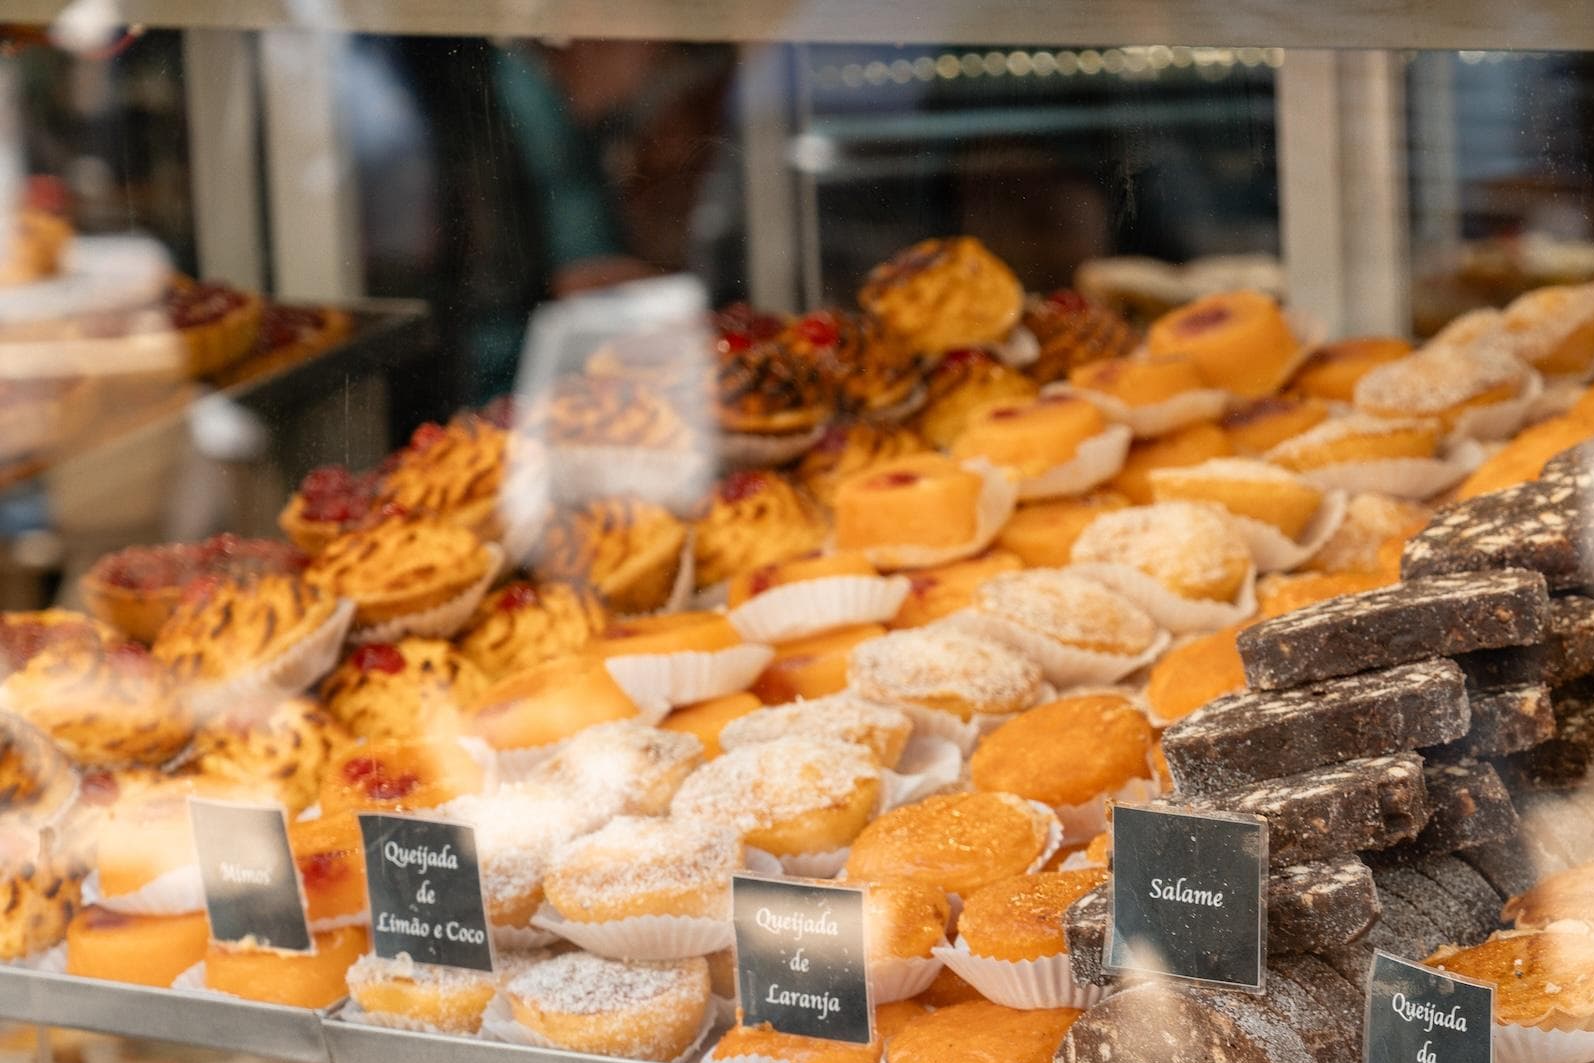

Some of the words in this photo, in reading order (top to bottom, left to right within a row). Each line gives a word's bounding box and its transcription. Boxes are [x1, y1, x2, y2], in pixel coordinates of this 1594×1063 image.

[384, 841, 459, 875] Queijada
[416, 880, 436, 905] de
[1149, 877, 1224, 907] Salame
[377, 912, 430, 938] Limão
[433, 924, 443, 939] e
[446, 921, 485, 945] Coco
[755, 907, 838, 941] Queijada
[789, 948, 810, 973] de
[765, 984, 841, 1020] Laranja
[1392, 992, 1468, 1033] Queijada
